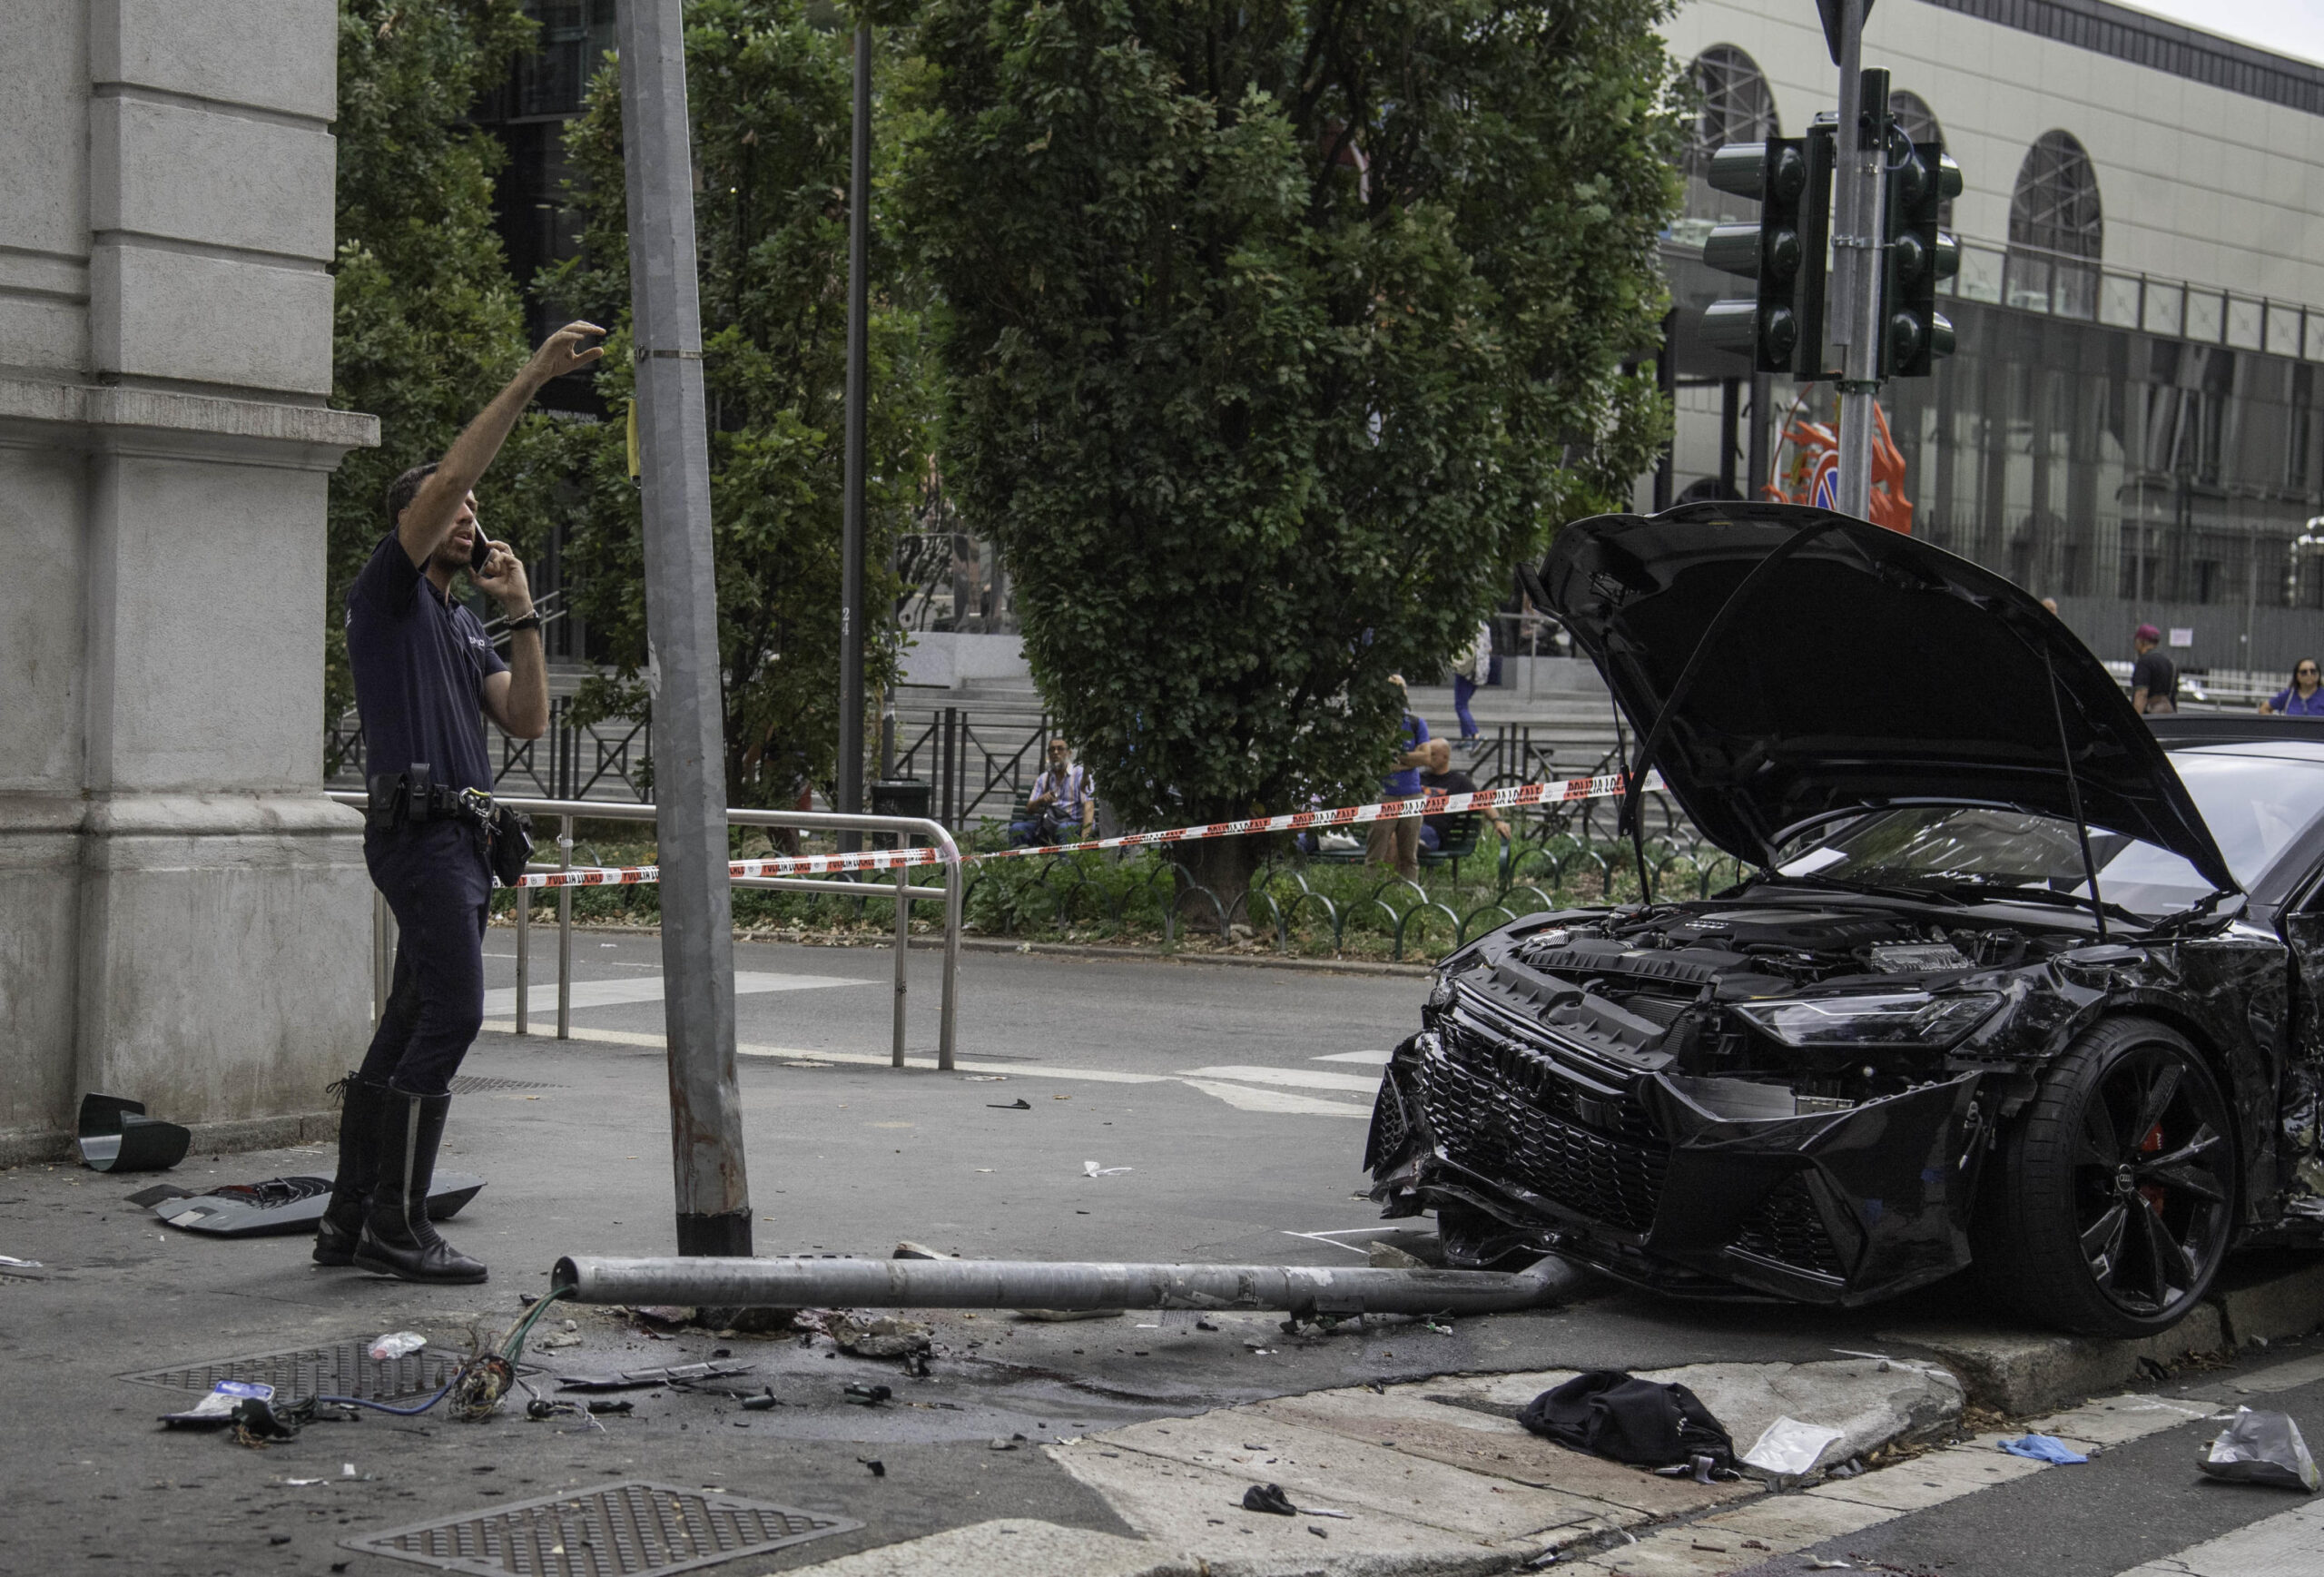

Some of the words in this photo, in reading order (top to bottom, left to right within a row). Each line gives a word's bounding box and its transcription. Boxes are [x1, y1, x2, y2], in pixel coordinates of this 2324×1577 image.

[842, 606, 851, 636] 24
[1472, 789, 1507, 808] POLIZIA
[1508, 785, 1541, 804] LOCALE
[1567, 779, 1603, 797] POLIZIA
